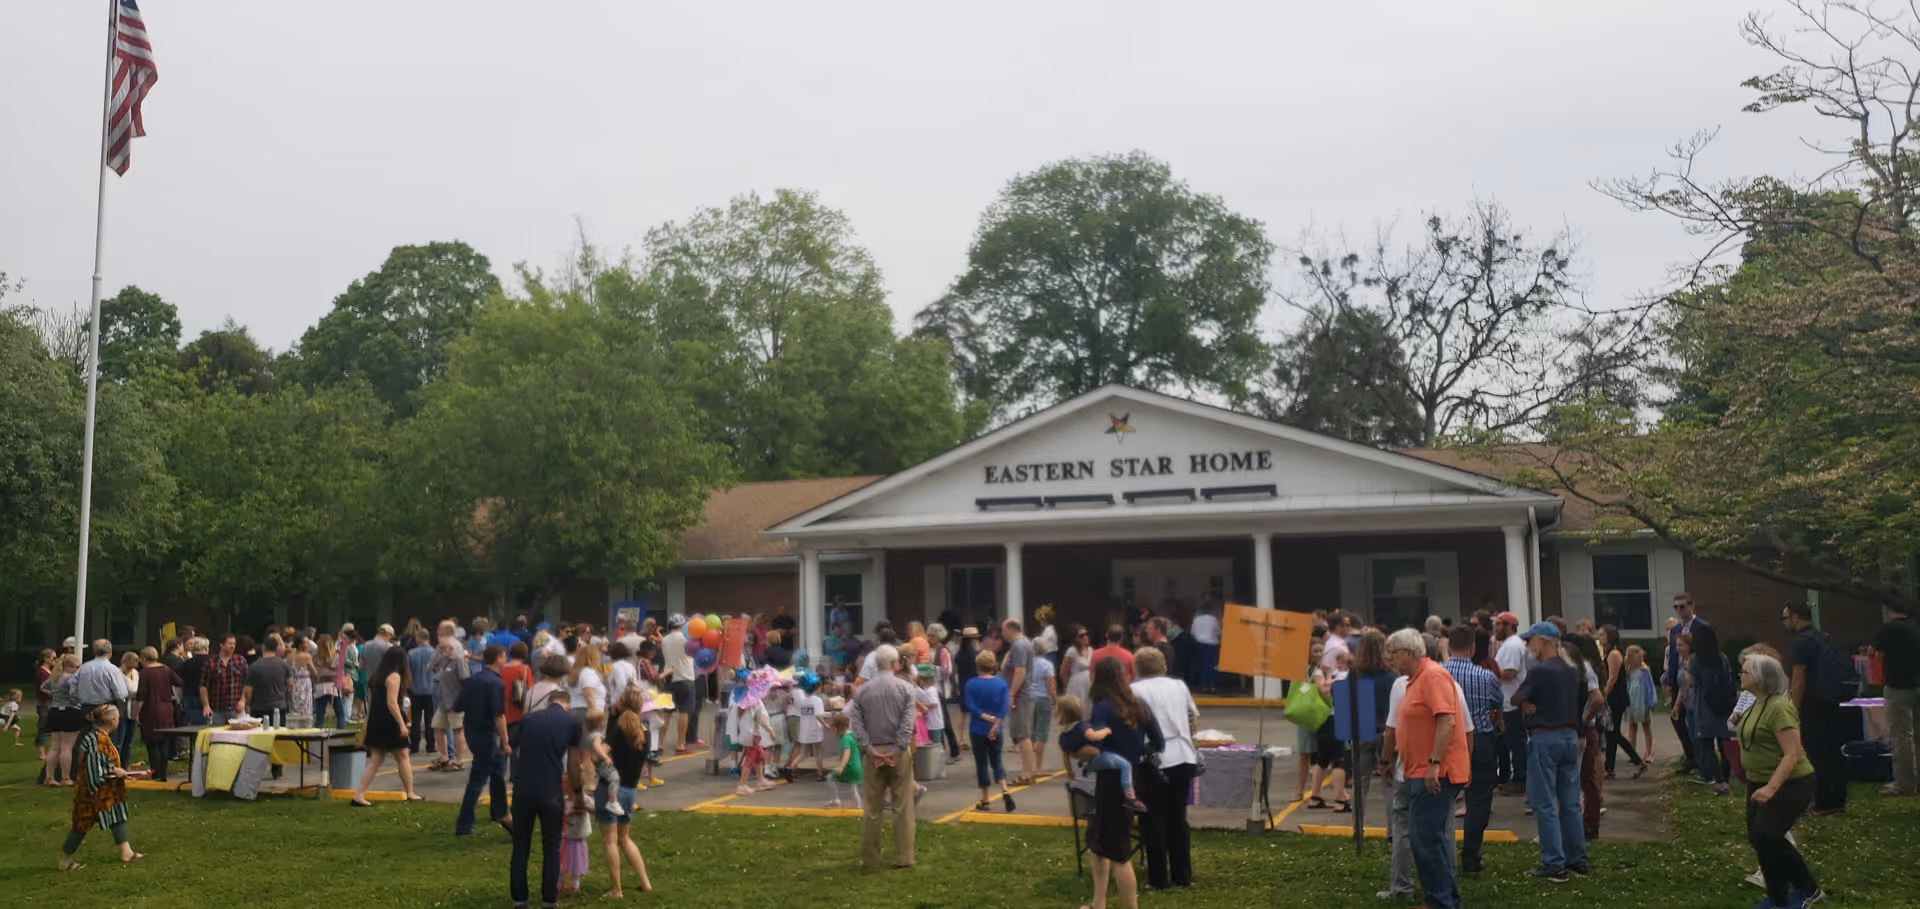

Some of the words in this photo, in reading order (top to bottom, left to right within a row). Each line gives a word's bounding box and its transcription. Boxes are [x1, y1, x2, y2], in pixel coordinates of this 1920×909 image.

[984, 460, 1095, 485] EASTERN
[1110, 455, 1173, 478] STAR
[1189, 450, 1273, 474] HOME
